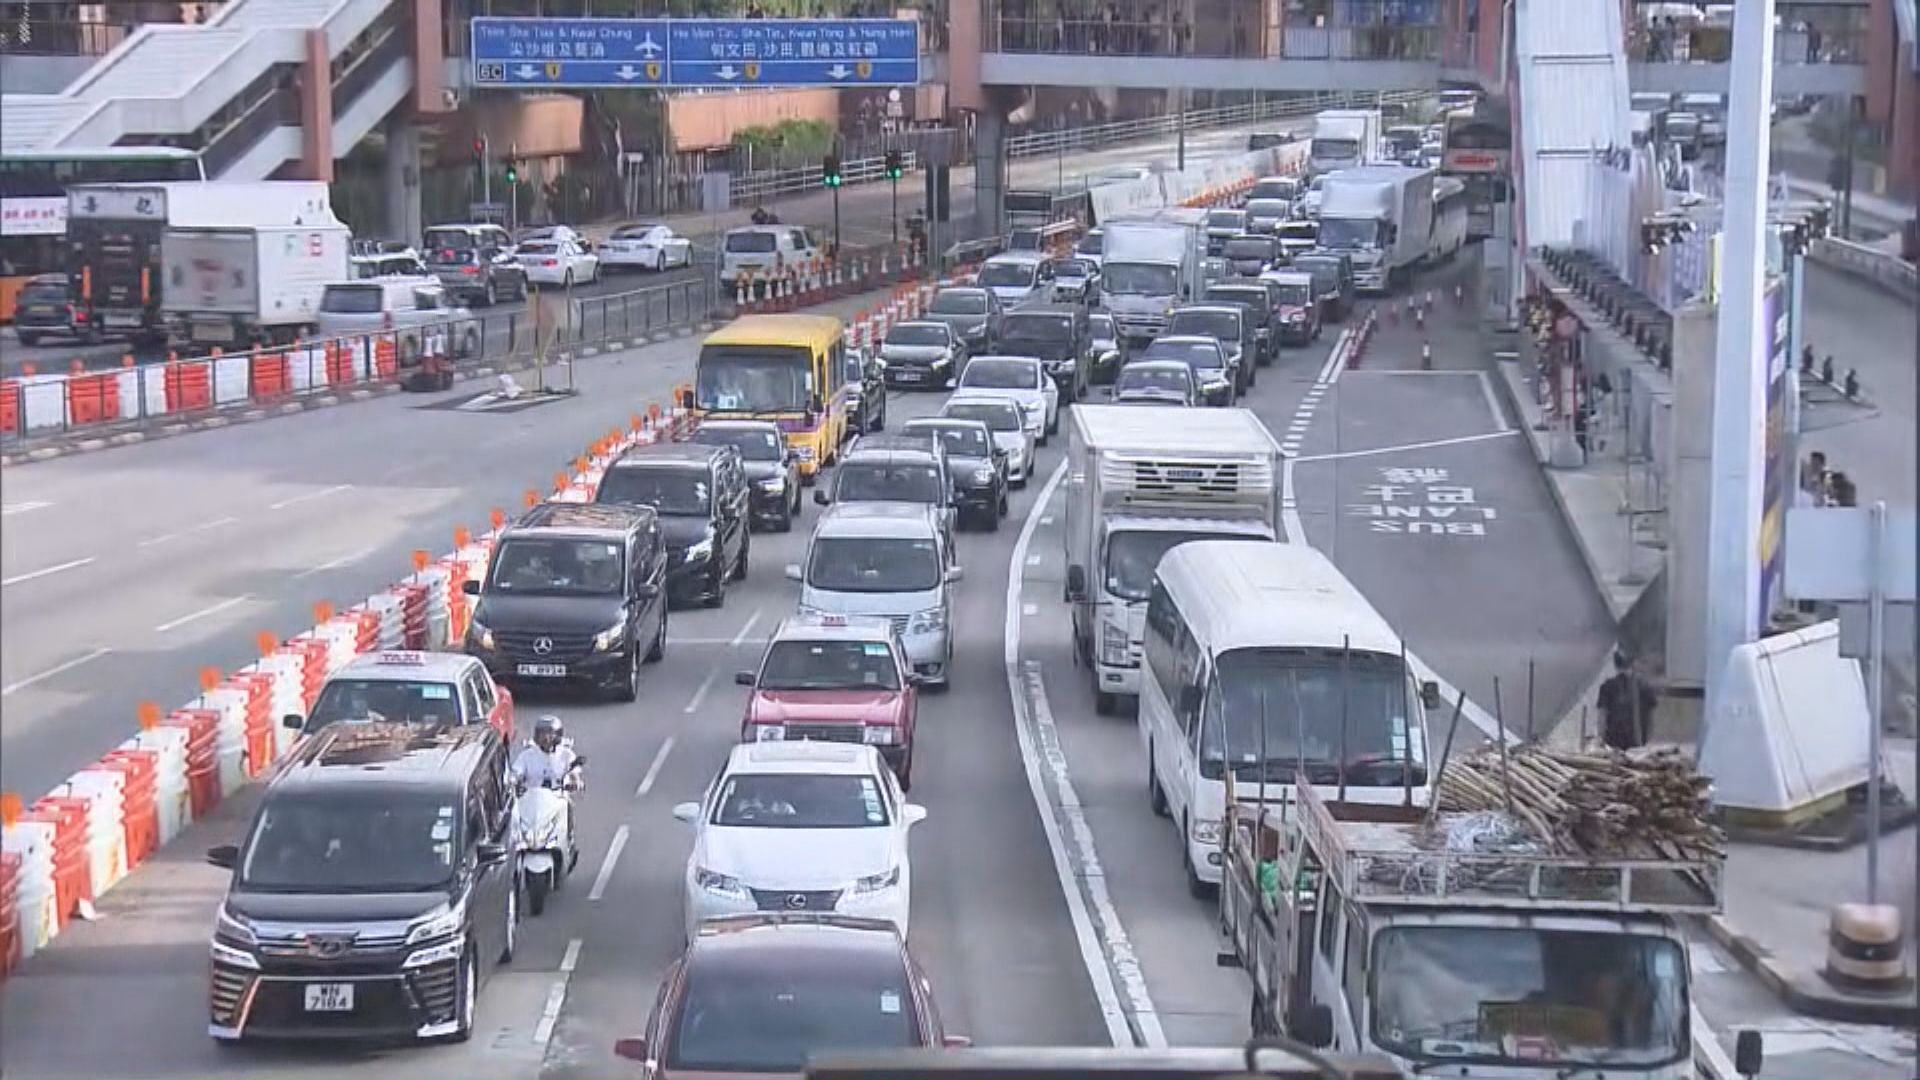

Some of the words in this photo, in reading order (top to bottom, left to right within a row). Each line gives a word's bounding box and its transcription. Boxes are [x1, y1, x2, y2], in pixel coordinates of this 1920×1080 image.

[559, 27, 567, 38] &
[571, 27, 596, 38] Kwai
[600, 27, 632, 40] Chung
[742, 27, 761, 38] Sha
[820, 28, 844, 39] Tong
[849, 28, 856, 38] &
[861, 28, 886, 39] Hung
[1362, 485, 1476, 504] 巴士
[1344, 503, 1497, 520] LANE
[1369, 520, 1486, 536] BUS
[382, 653, 421, 663] TAXI
